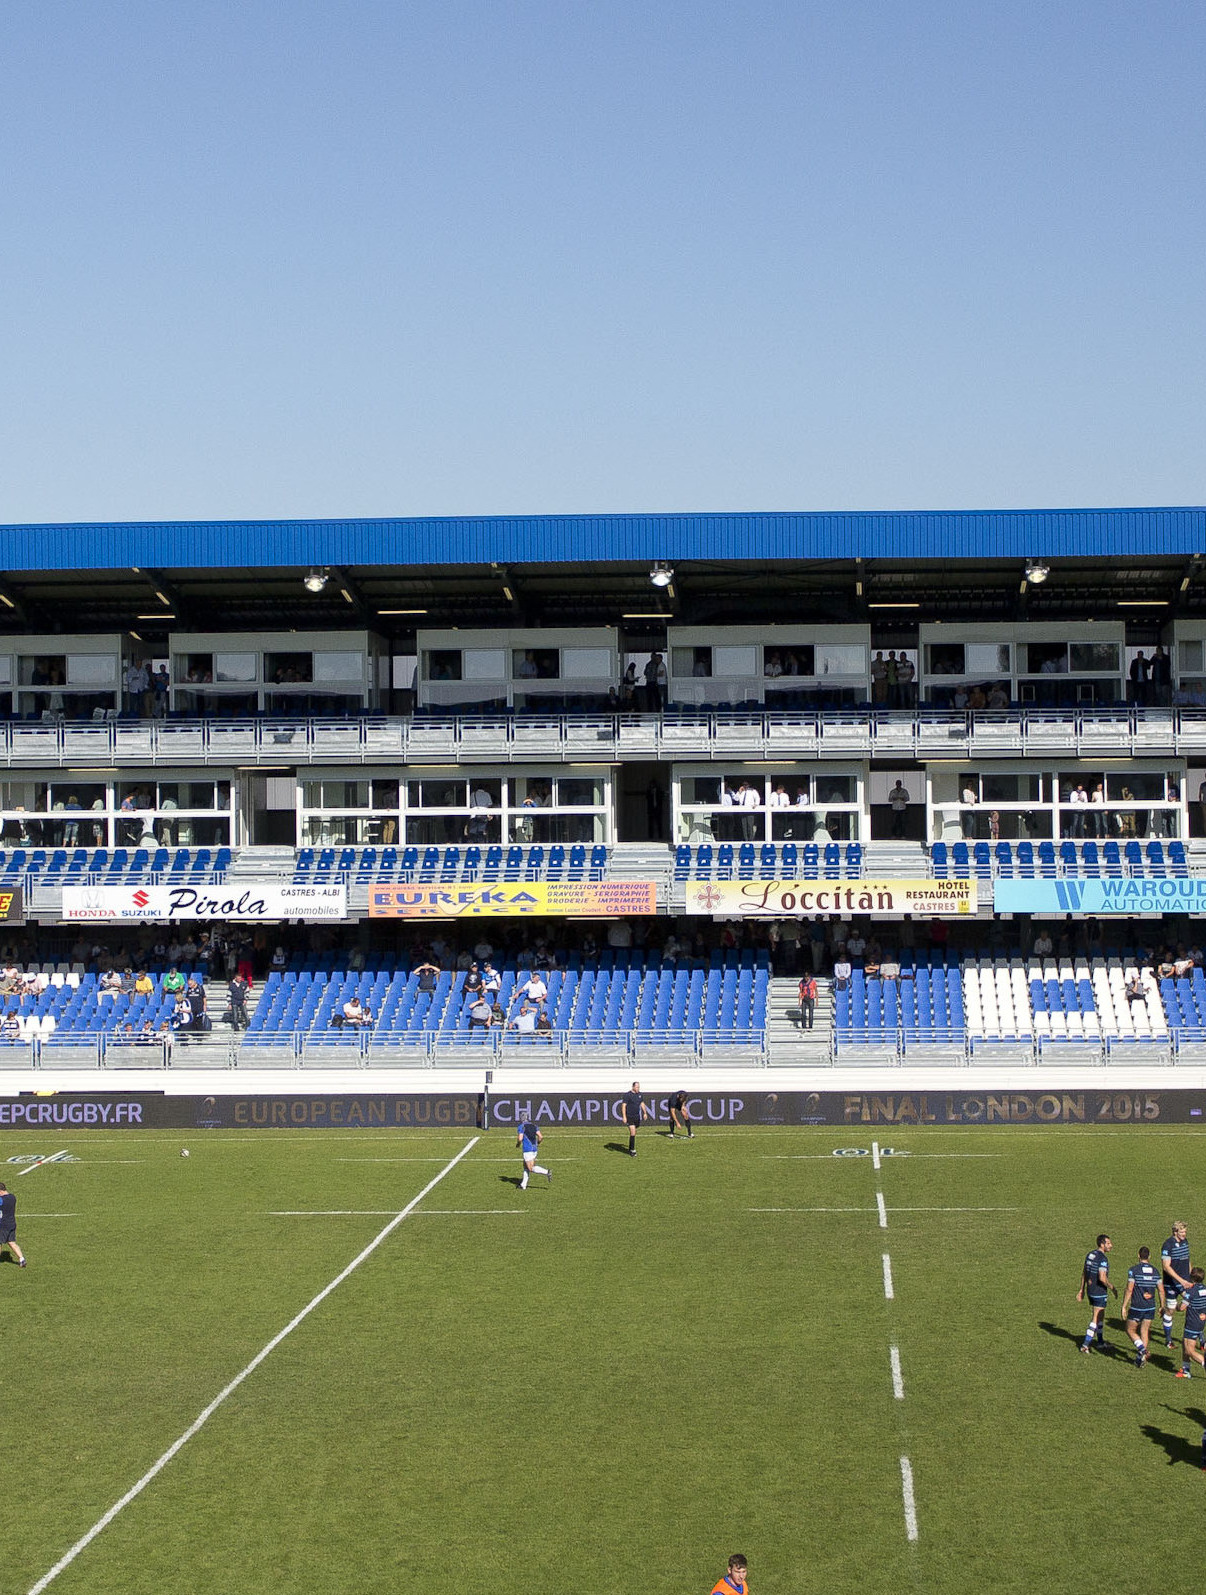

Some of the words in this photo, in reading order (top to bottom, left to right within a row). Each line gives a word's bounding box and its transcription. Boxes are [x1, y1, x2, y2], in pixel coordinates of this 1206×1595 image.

[938, 879, 970, 890] HÔTEL
[281, 889, 316, 897] CASTRES
[322, 889, 341, 897] ALBI
[374, 890, 538, 905] EUREKA
[906, 891, 970, 899] RESTAURANT
[168, 888, 268, 916] Pirola
[913, 902, 956, 911] CASTRES
[283, 906, 340, 915] automobiles
[606, 905, 651, 913] CASTRES
[0, 1103, 143, 1123] EPCRUGBY.FR
[234, 1099, 386, 1123] EUROPEAN
[395, 1099, 484, 1123] RUGBY
[686, 1098, 744, 1120] CUP
[844, 1095, 936, 1121] FINAL
[946, 1094, 1085, 1121] LONDON
[1096, 1094, 1161, 1120] 2015
